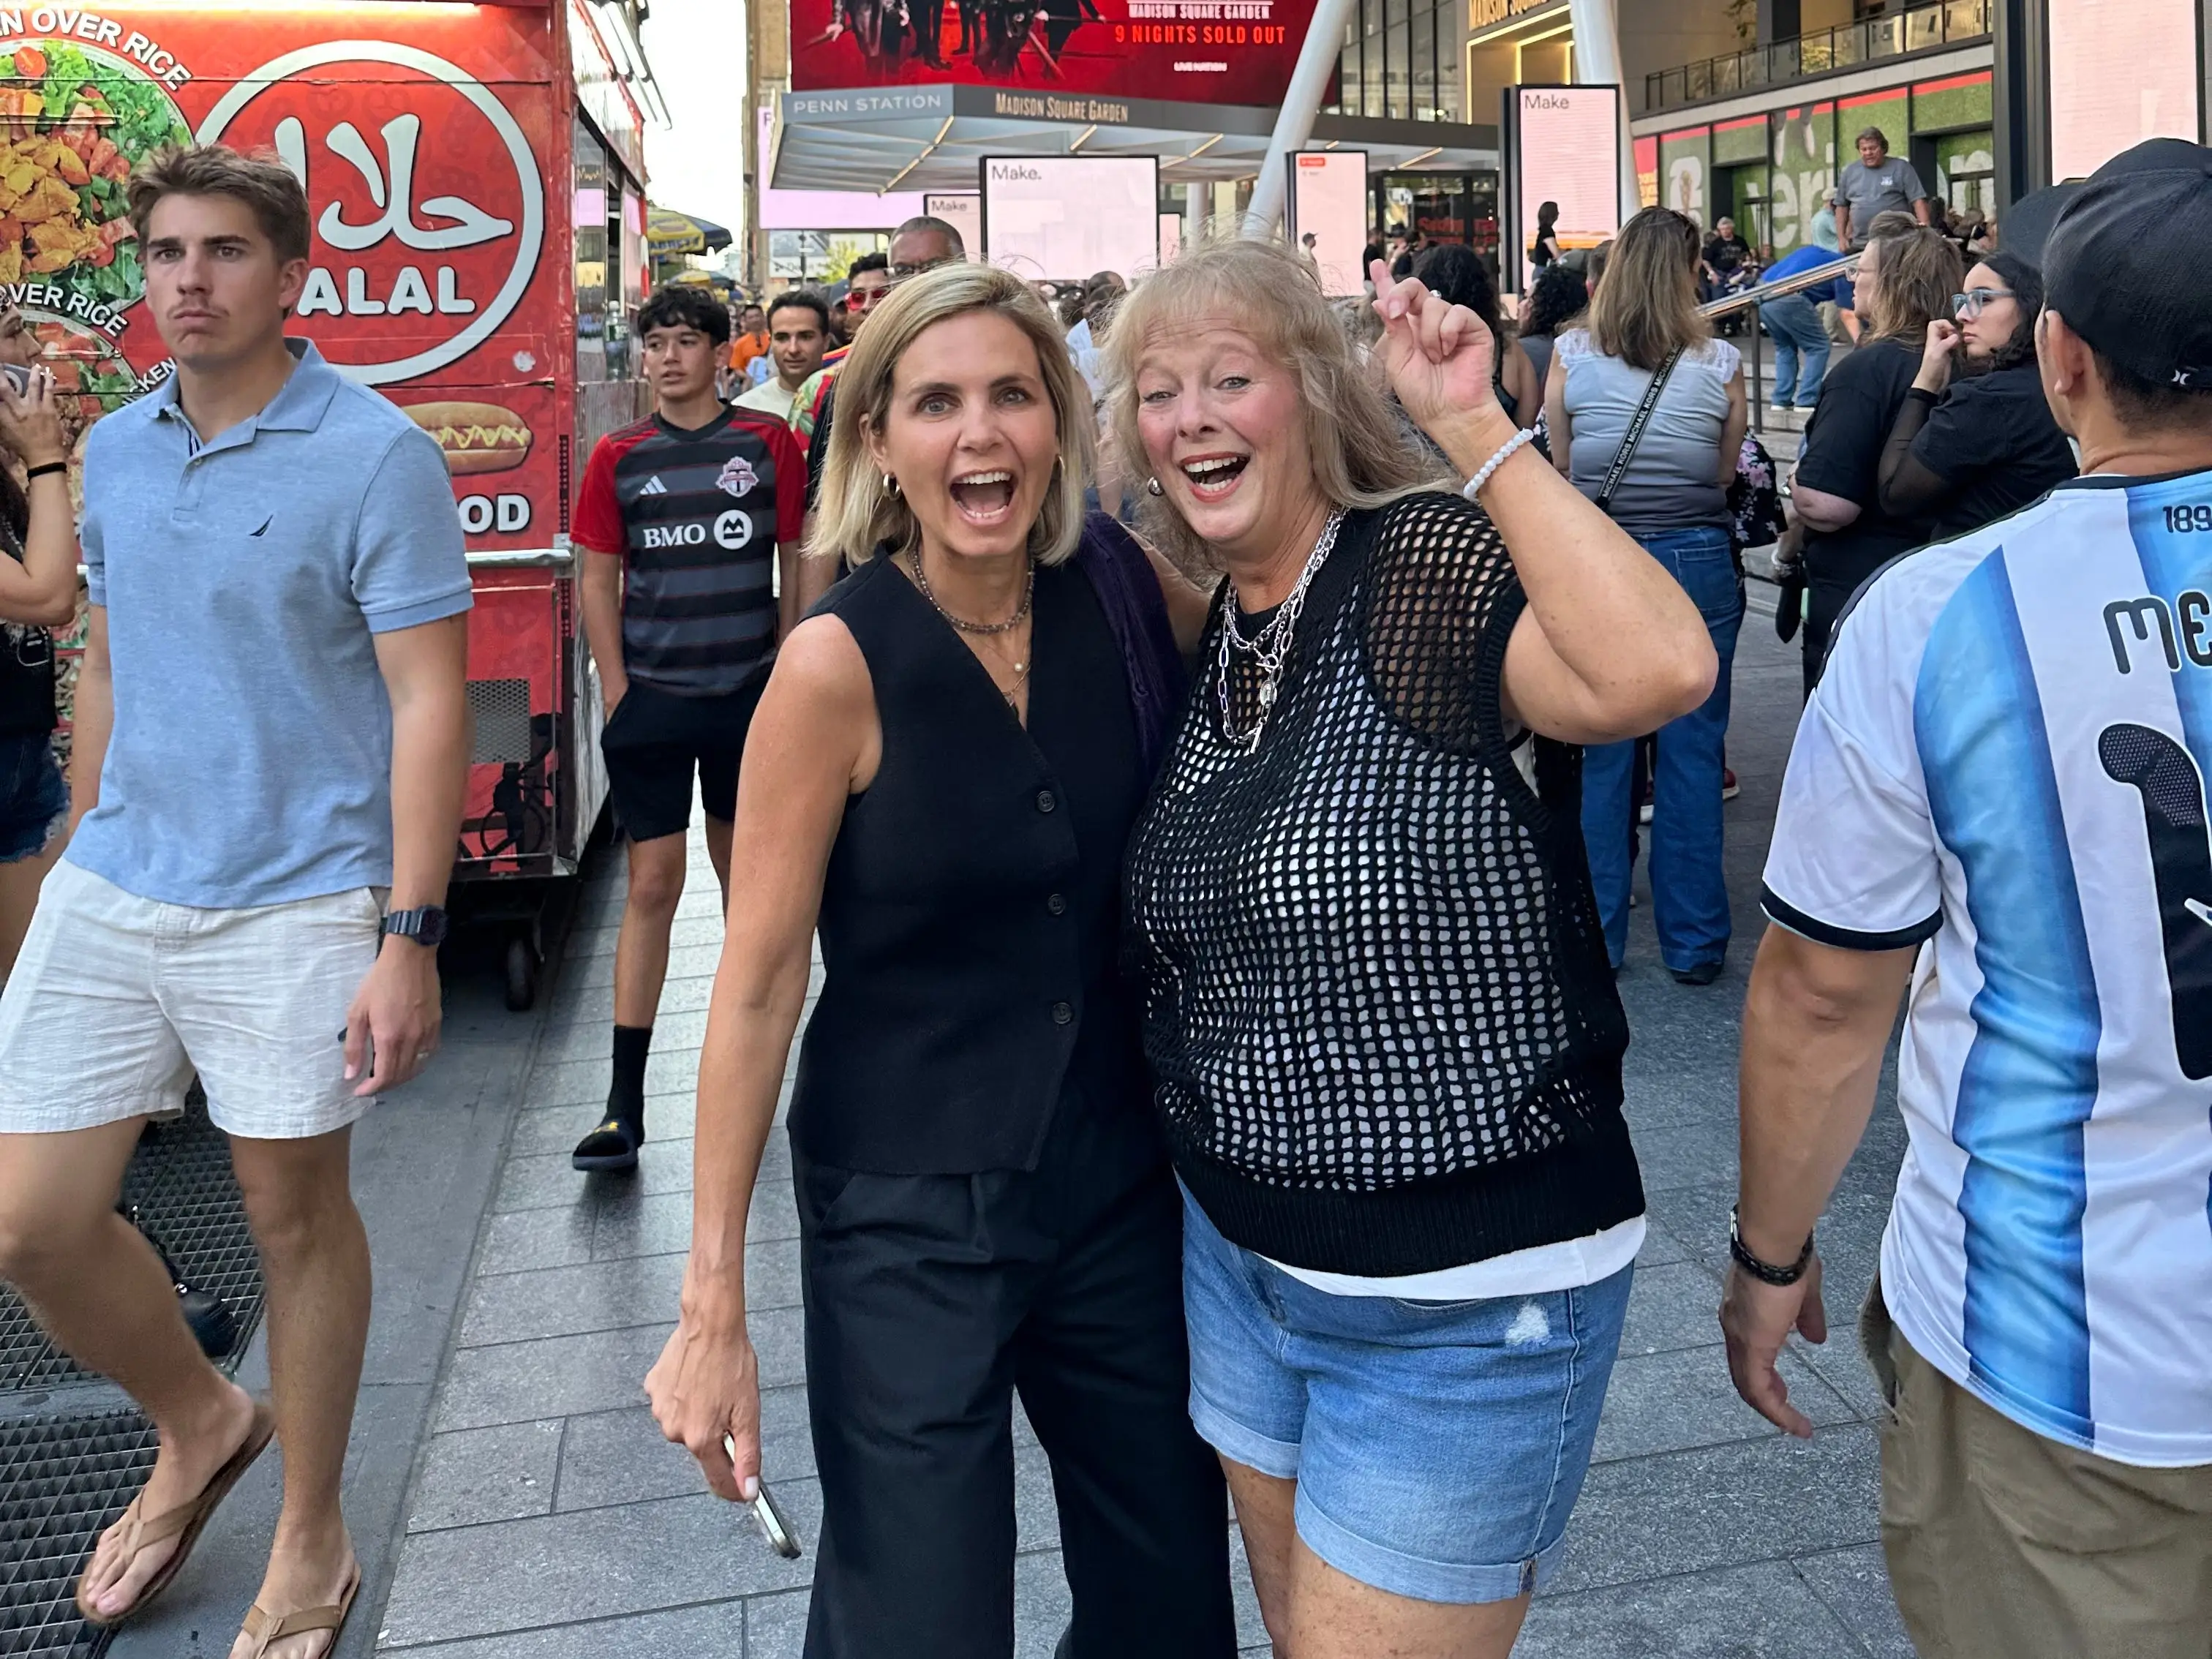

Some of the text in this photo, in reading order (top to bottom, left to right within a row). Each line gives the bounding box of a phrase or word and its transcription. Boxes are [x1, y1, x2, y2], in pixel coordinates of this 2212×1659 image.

[1129, 4, 1270, 20] MADISON SQUARE GARDEN
[1115, 25, 1285, 44] 9 NIGHTS SOLD OUT
[0, 8, 192, 91] N OVER RICE
[793, 94, 941, 113] PENN STATION
[995, 92, 1128, 123] MADISON SQUARE GARDEN
[1524, 94, 1570, 109] Make
[991, 165, 1042, 181] Make.
[296, 265, 476, 317] ALAL
[66, 292, 128, 338] RICE
[1602, 466, 1622, 497] MICHAEL
[1617, 443, 1632, 464] KORS
[1627, 410, 1648, 443] MICHAEL
[1643, 386, 1659, 409] KORS
[457, 494, 531, 535] OD
[2163, 505, 2212, 533] 189
[643, 523, 706, 549] BMO
[2103, 589, 2212, 675] ME
